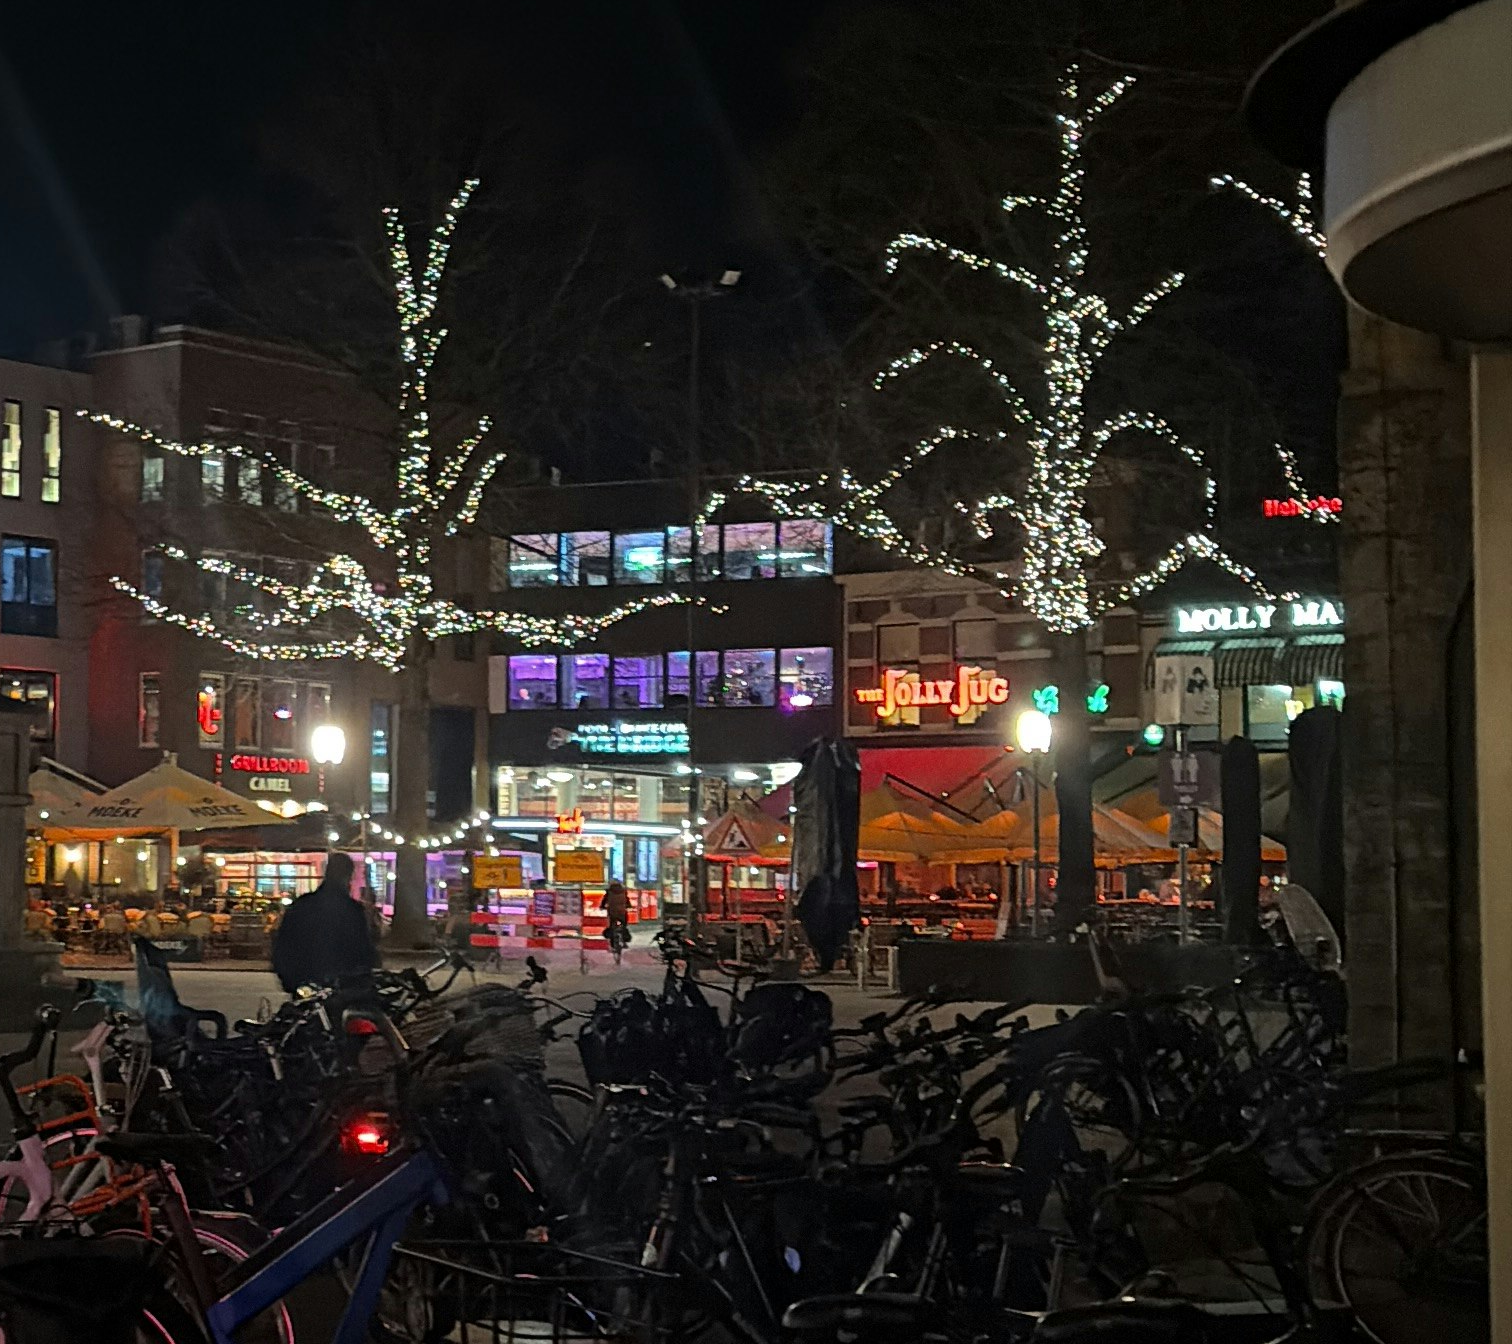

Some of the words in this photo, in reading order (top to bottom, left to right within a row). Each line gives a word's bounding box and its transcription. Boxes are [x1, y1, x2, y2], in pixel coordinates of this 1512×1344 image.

[1177, 604, 1277, 633] MOLLY
[1291, 601, 1345, 627] MA
[855, 688, 884, 703] THE
[876, 668, 956, 718] JOLLY
[949, 665, 1010, 716] JUG
[231, 754, 310, 774] GRILLROOM
[249, 777, 292, 793] CAMEL
